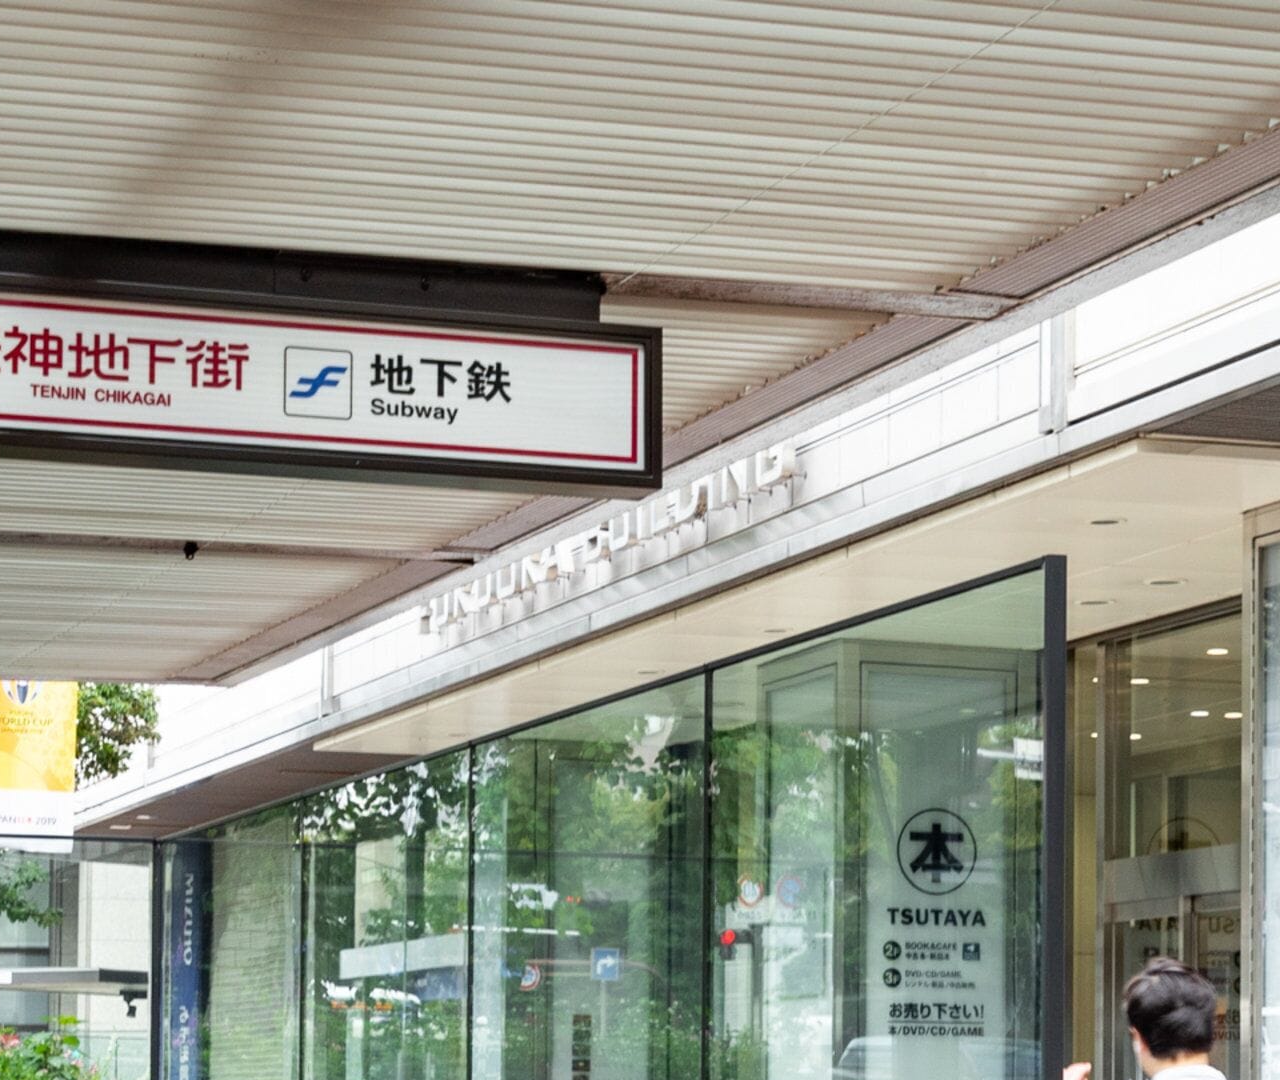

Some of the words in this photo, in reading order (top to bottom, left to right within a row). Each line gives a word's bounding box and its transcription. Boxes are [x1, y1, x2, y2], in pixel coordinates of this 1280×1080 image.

[370, 354, 512, 404] 地下鉄
[30, 383, 86, 401] TENJIN
[95, 387, 172, 408] CHIKAGAI
[370, 398, 459, 425] Subway
[583, 443, 798, 562] BUILDING
[33, 717, 54, 726] CUP
[886, 907, 986, 927] TSUTAYA
[904, 970, 962, 978] DVD/CD/GAME
[888, 1003, 984, 1020] お売り下さい!
[888, 1025, 984, 1037] 本/DVD/CD/GAME
